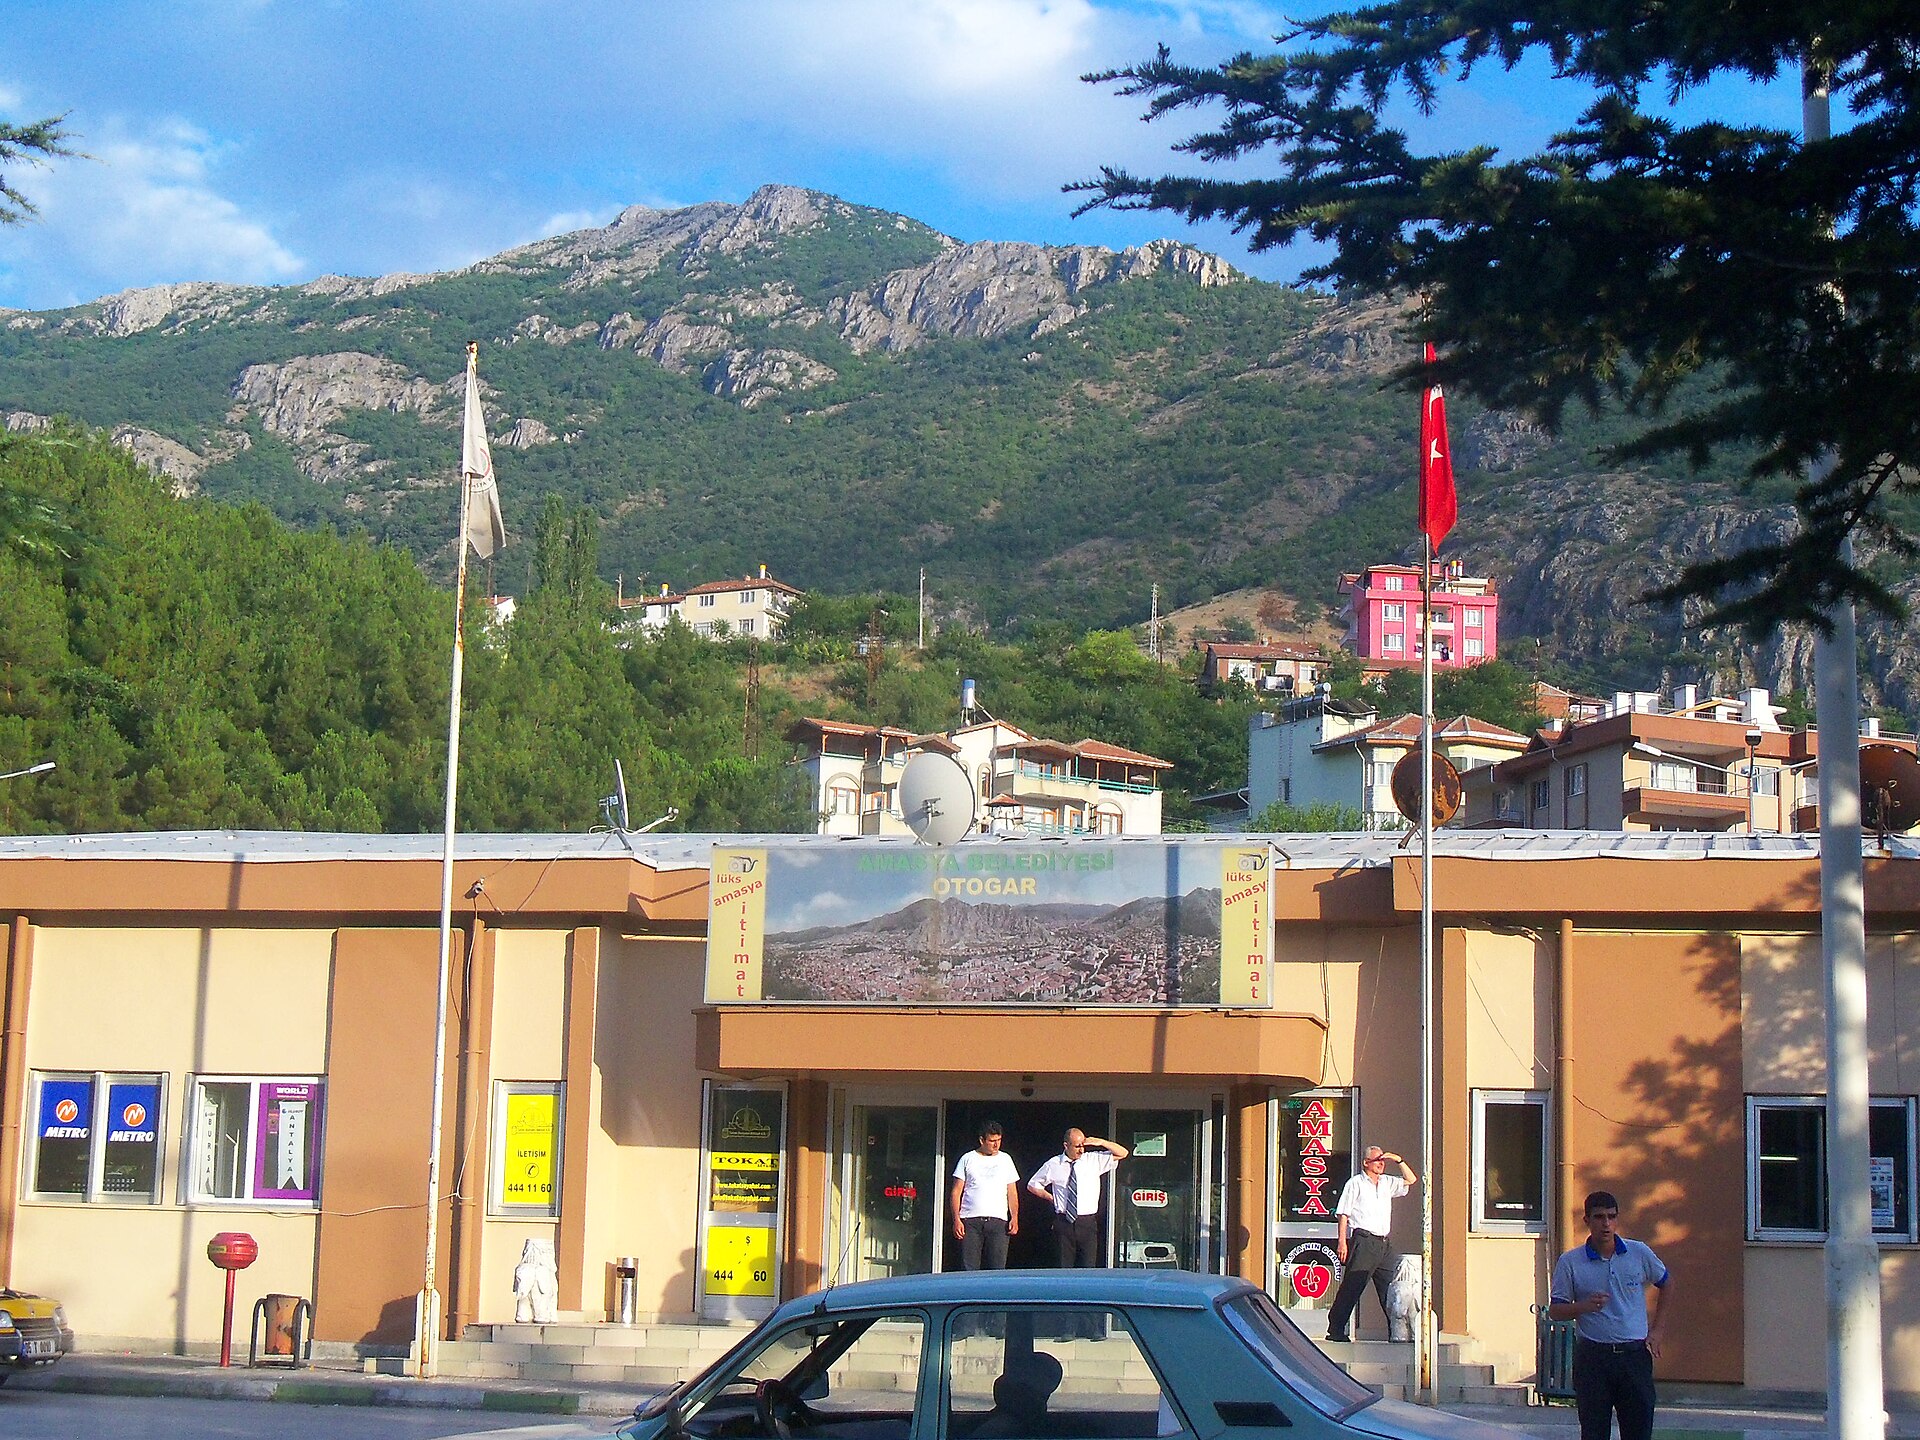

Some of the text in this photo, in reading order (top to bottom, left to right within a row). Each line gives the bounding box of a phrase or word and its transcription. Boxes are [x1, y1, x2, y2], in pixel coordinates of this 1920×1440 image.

[857, 849, 1115, 871] AMASYA BELEDİYESİ
[716, 873, 742, 884] lüks
[1226, 872, 1253, 882] lüks
[713, 880, 763, 907] amasya
[933, 877, 1036, 896] OTOGAR
[1224, 880, 1268, 906] amasy
[733, 901, 749, 997] itimat
[1247, 900, 1264, 999] itimat
[276, 1086, 309, 1095] WORLD
[45, 1126, 90, 1139] METRO
[109, 1130, 156, 1142] METRO
[205, 1118, 213, 1173] BURSA
[287, 1114, 296, 1172] ANTALYA
[714, 1156, 779, 1165] TOKAT
[1298, 1101, 1333, 1214] AMASYA
[507, 1183, 552, 1193] 444 11 60
[1133, 1190, 1166, 1204] GİRİŞ
[713, 1270, 767, 1282] 444 60
